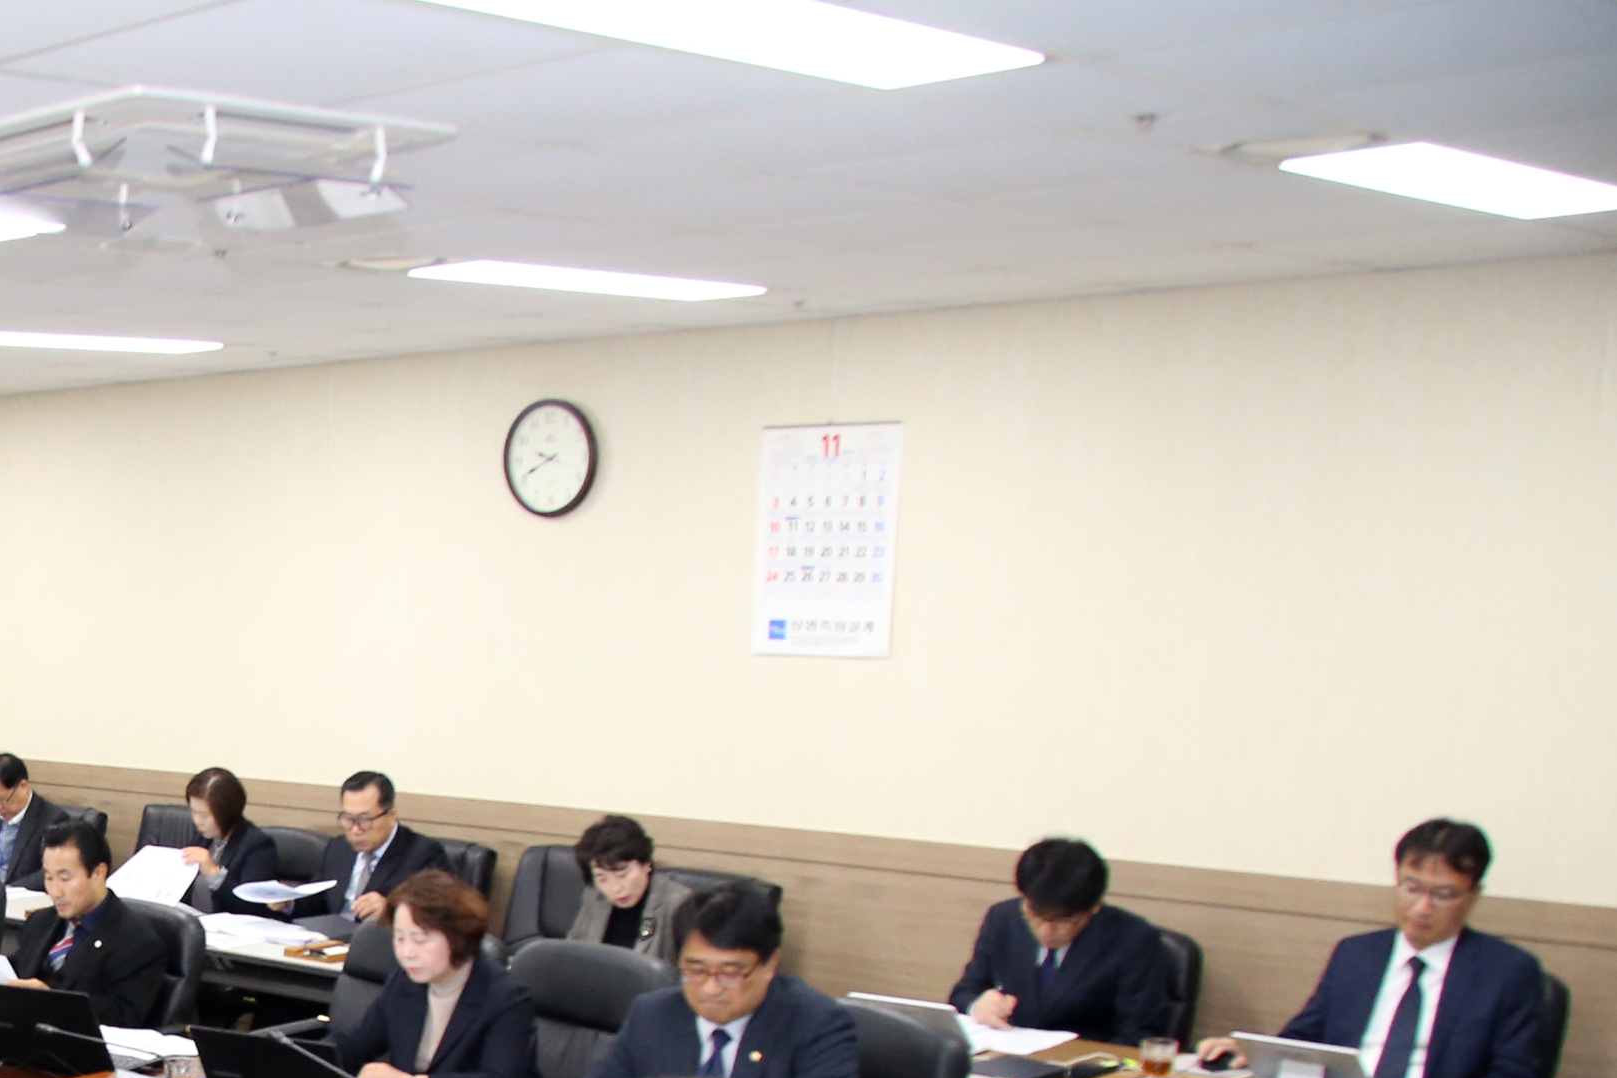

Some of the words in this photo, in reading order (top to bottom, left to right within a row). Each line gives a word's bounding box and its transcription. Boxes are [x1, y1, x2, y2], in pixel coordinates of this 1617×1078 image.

[821, 433, 841, 459] 11
[805, 520, 816, 533] 12
[840, 520, 850, 533] 14
[821, 546, 833, 558] 20
